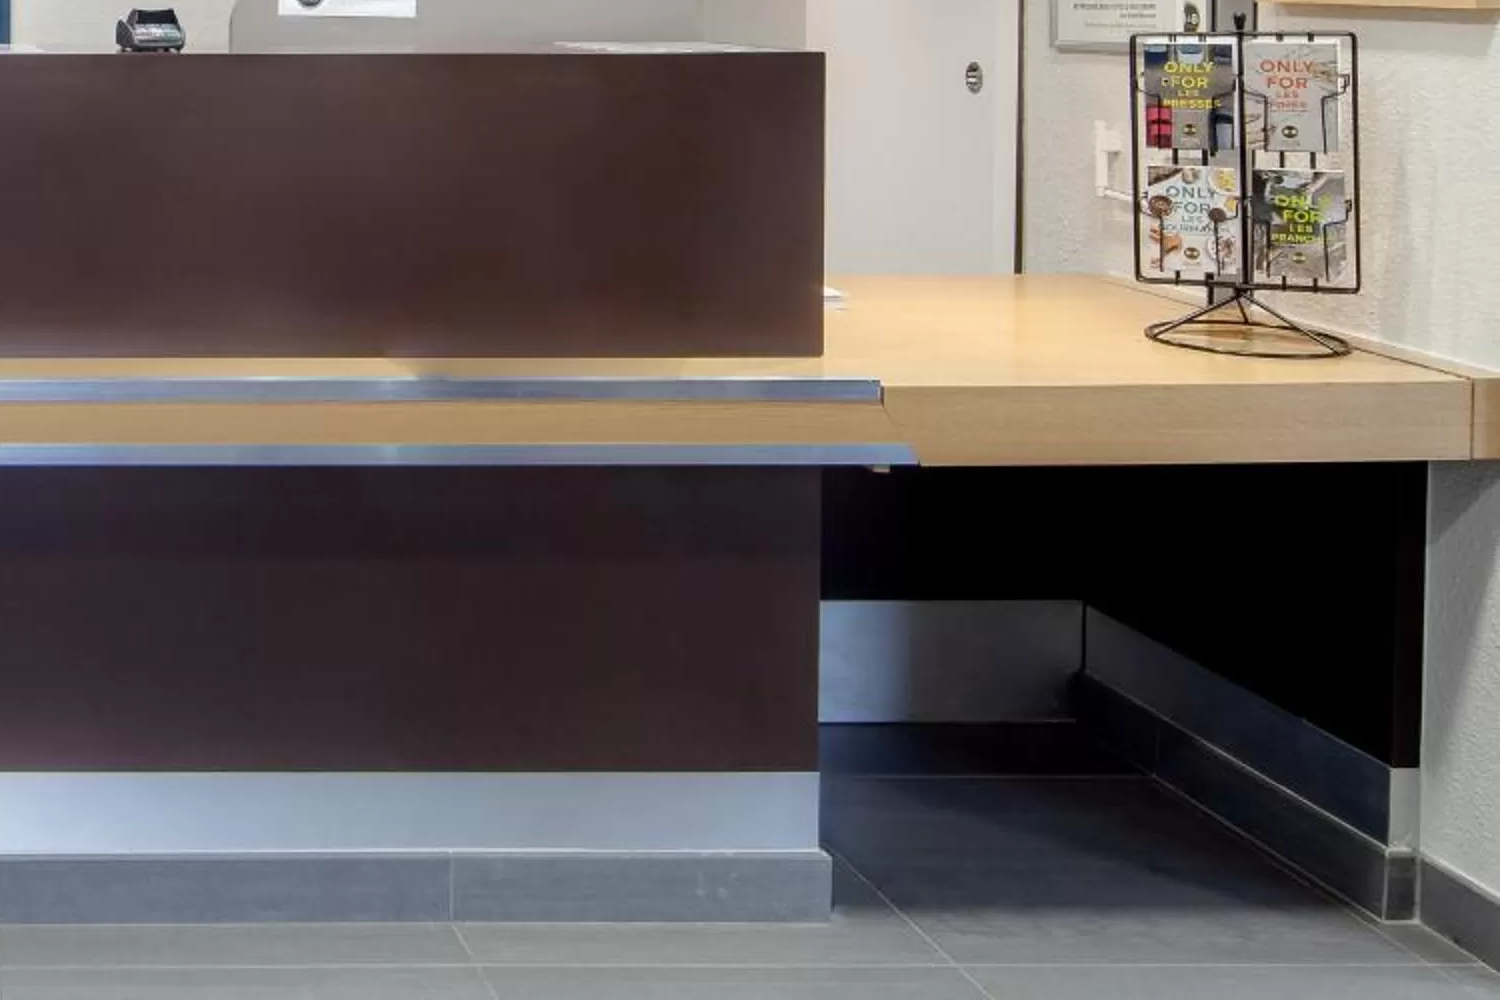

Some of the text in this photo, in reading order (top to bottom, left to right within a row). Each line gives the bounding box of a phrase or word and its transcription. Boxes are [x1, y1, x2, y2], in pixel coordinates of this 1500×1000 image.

[1164, 61, 1215, 74] ONLY
[1259, 59, 1315, 73] ONLY
[1170, 75, 1209, 90] FOR
[1266, 75, 1309, 89] FOR
[1165, 184, 1217, 199] ONLY
[1171, 201, 1212, 215] FOR
[1282, 209, 1326, 223] FOR
